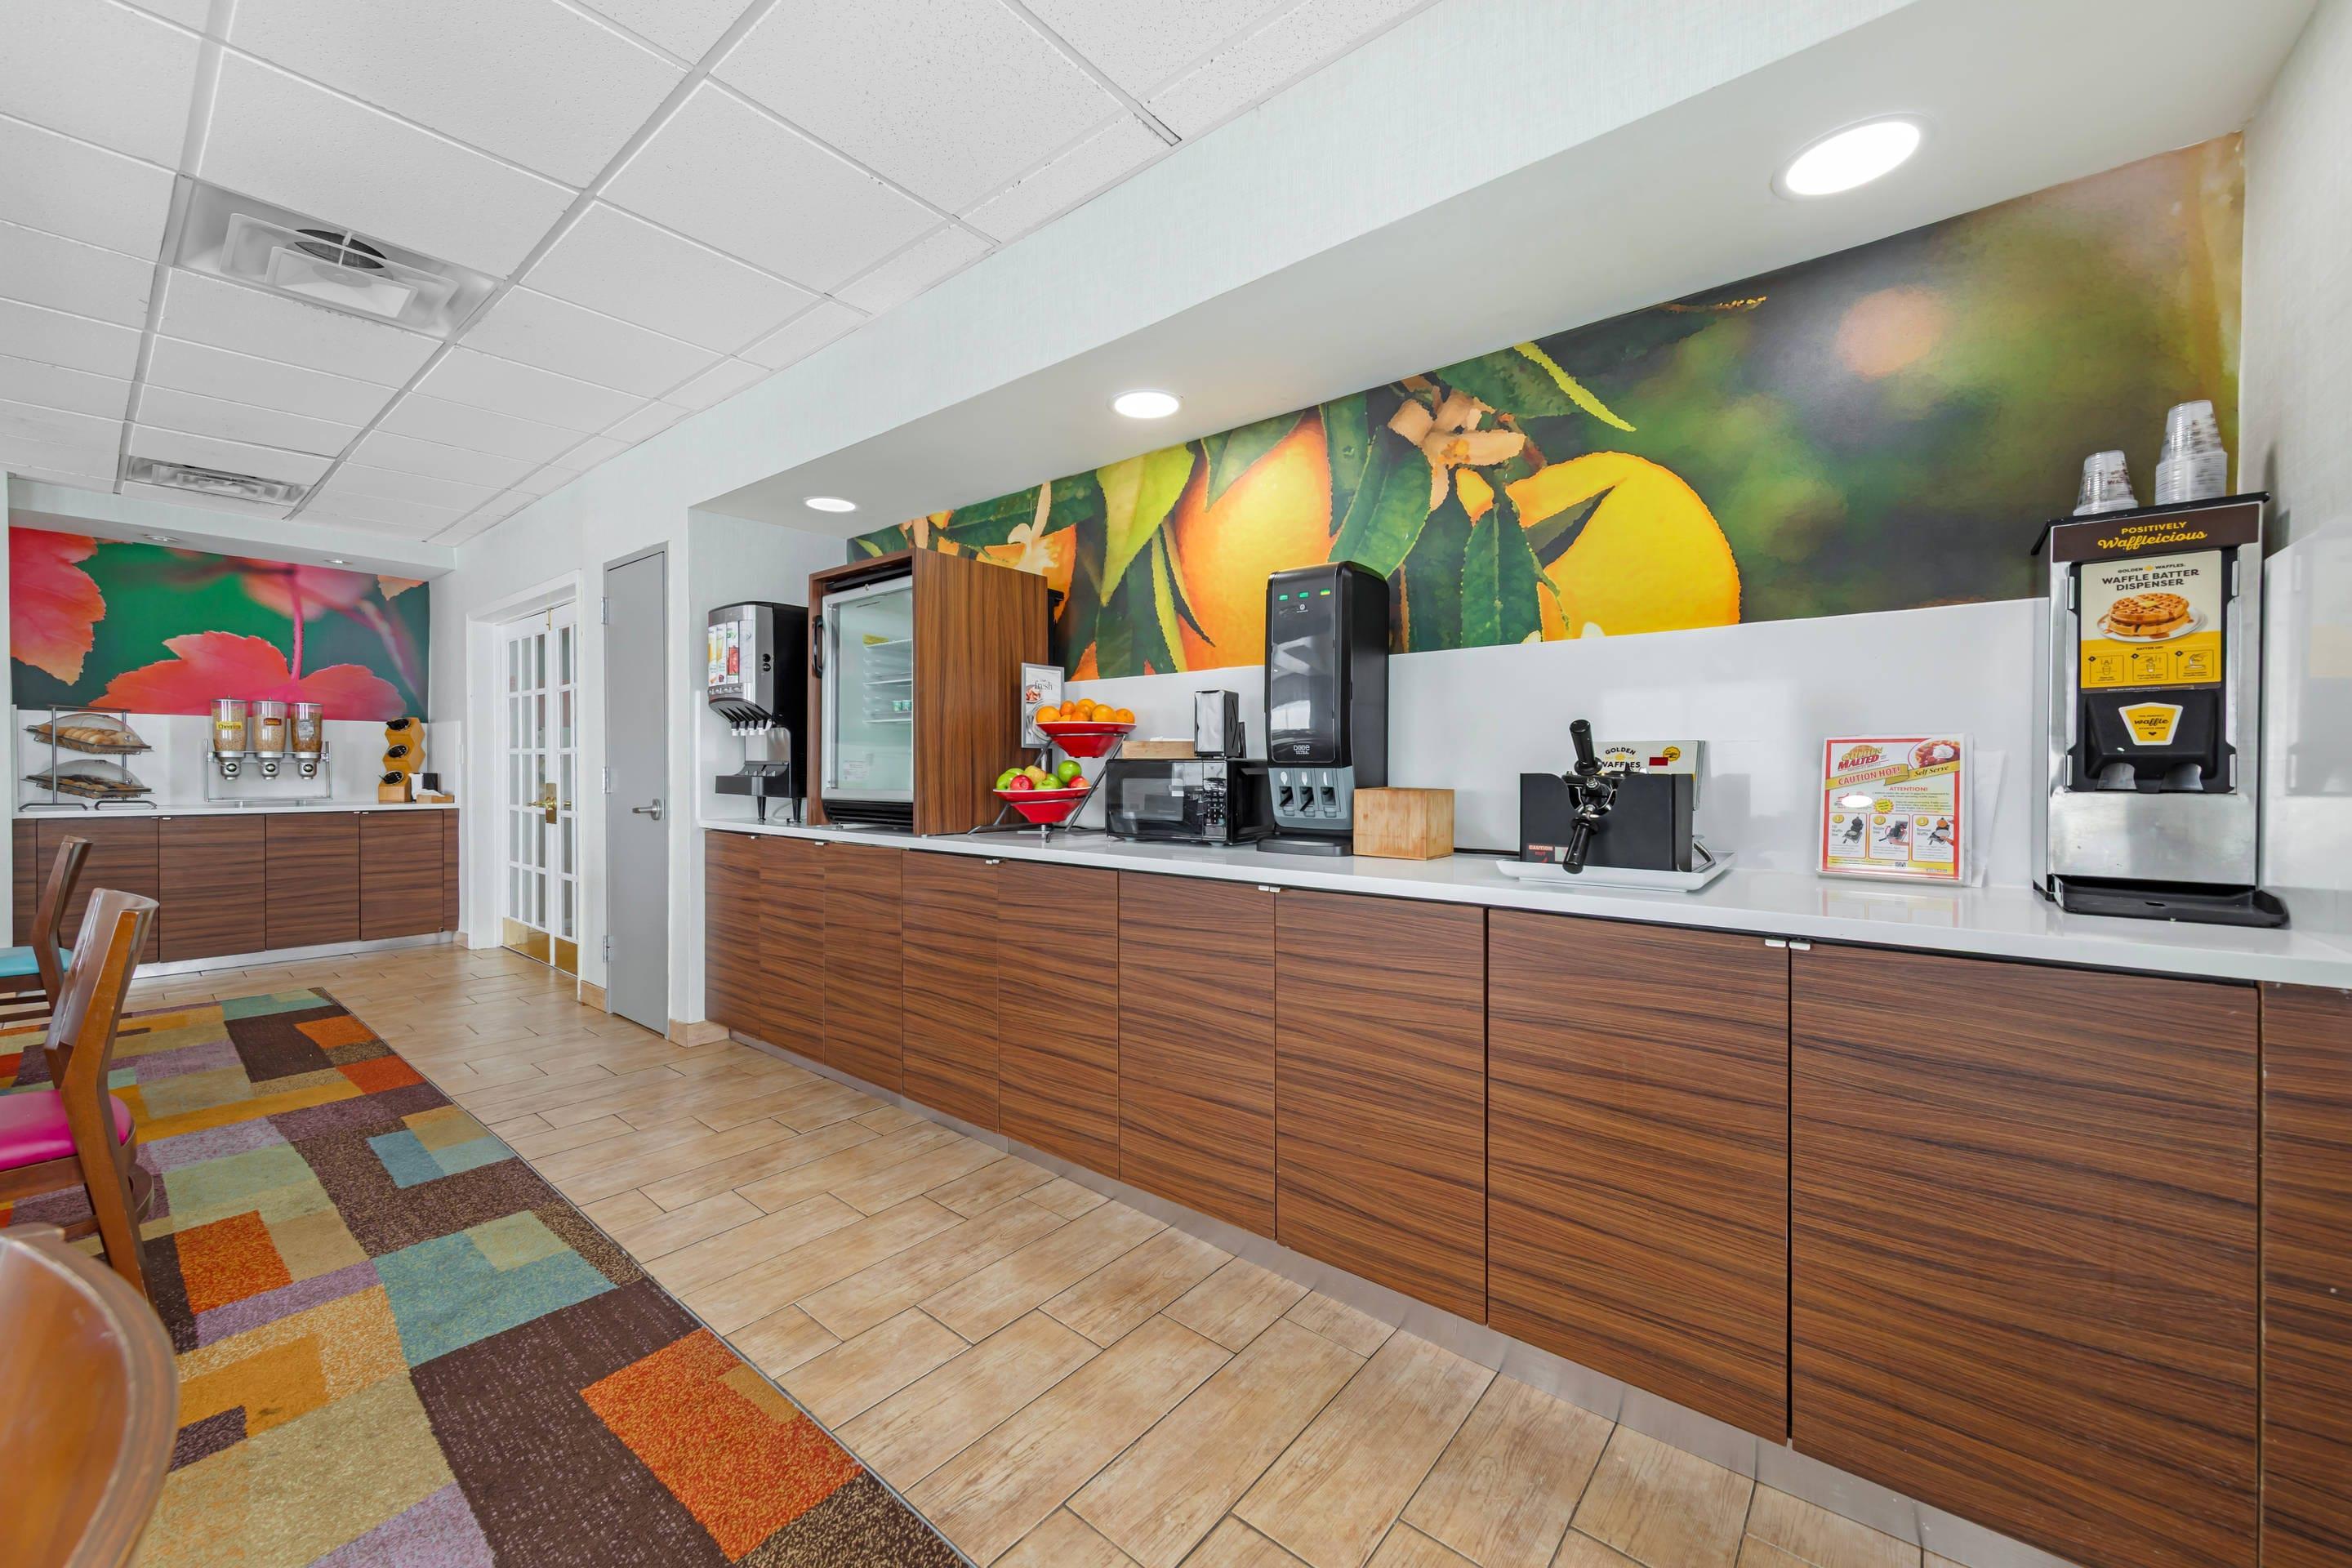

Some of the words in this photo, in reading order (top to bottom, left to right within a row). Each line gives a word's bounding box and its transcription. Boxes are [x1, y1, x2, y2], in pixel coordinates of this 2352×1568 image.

[2121, 521, 2187, 535] POSITIVELY
[2097, 529, 2207, 550] Waffleicious
[2102, 573, 2149, 585] WAFFLE
[2153, 568, 2199, 580] BATTER
[2117, 578, 2185, 591] DISPENSER
[1035, 679, 1053, 691] fresh
[2134, 718, 2169, 727] waffle
[1605, 746, 1636, 755] GOLDEN
[1838, 754, 1880, 770] MALTED
[1838, 772, 1877, 785] CAUTION
[1878, 766, 1900, 777] HOT!
[1914, 768, 1928, 777] Self
[1928, 765, 1949, 774] Serve
